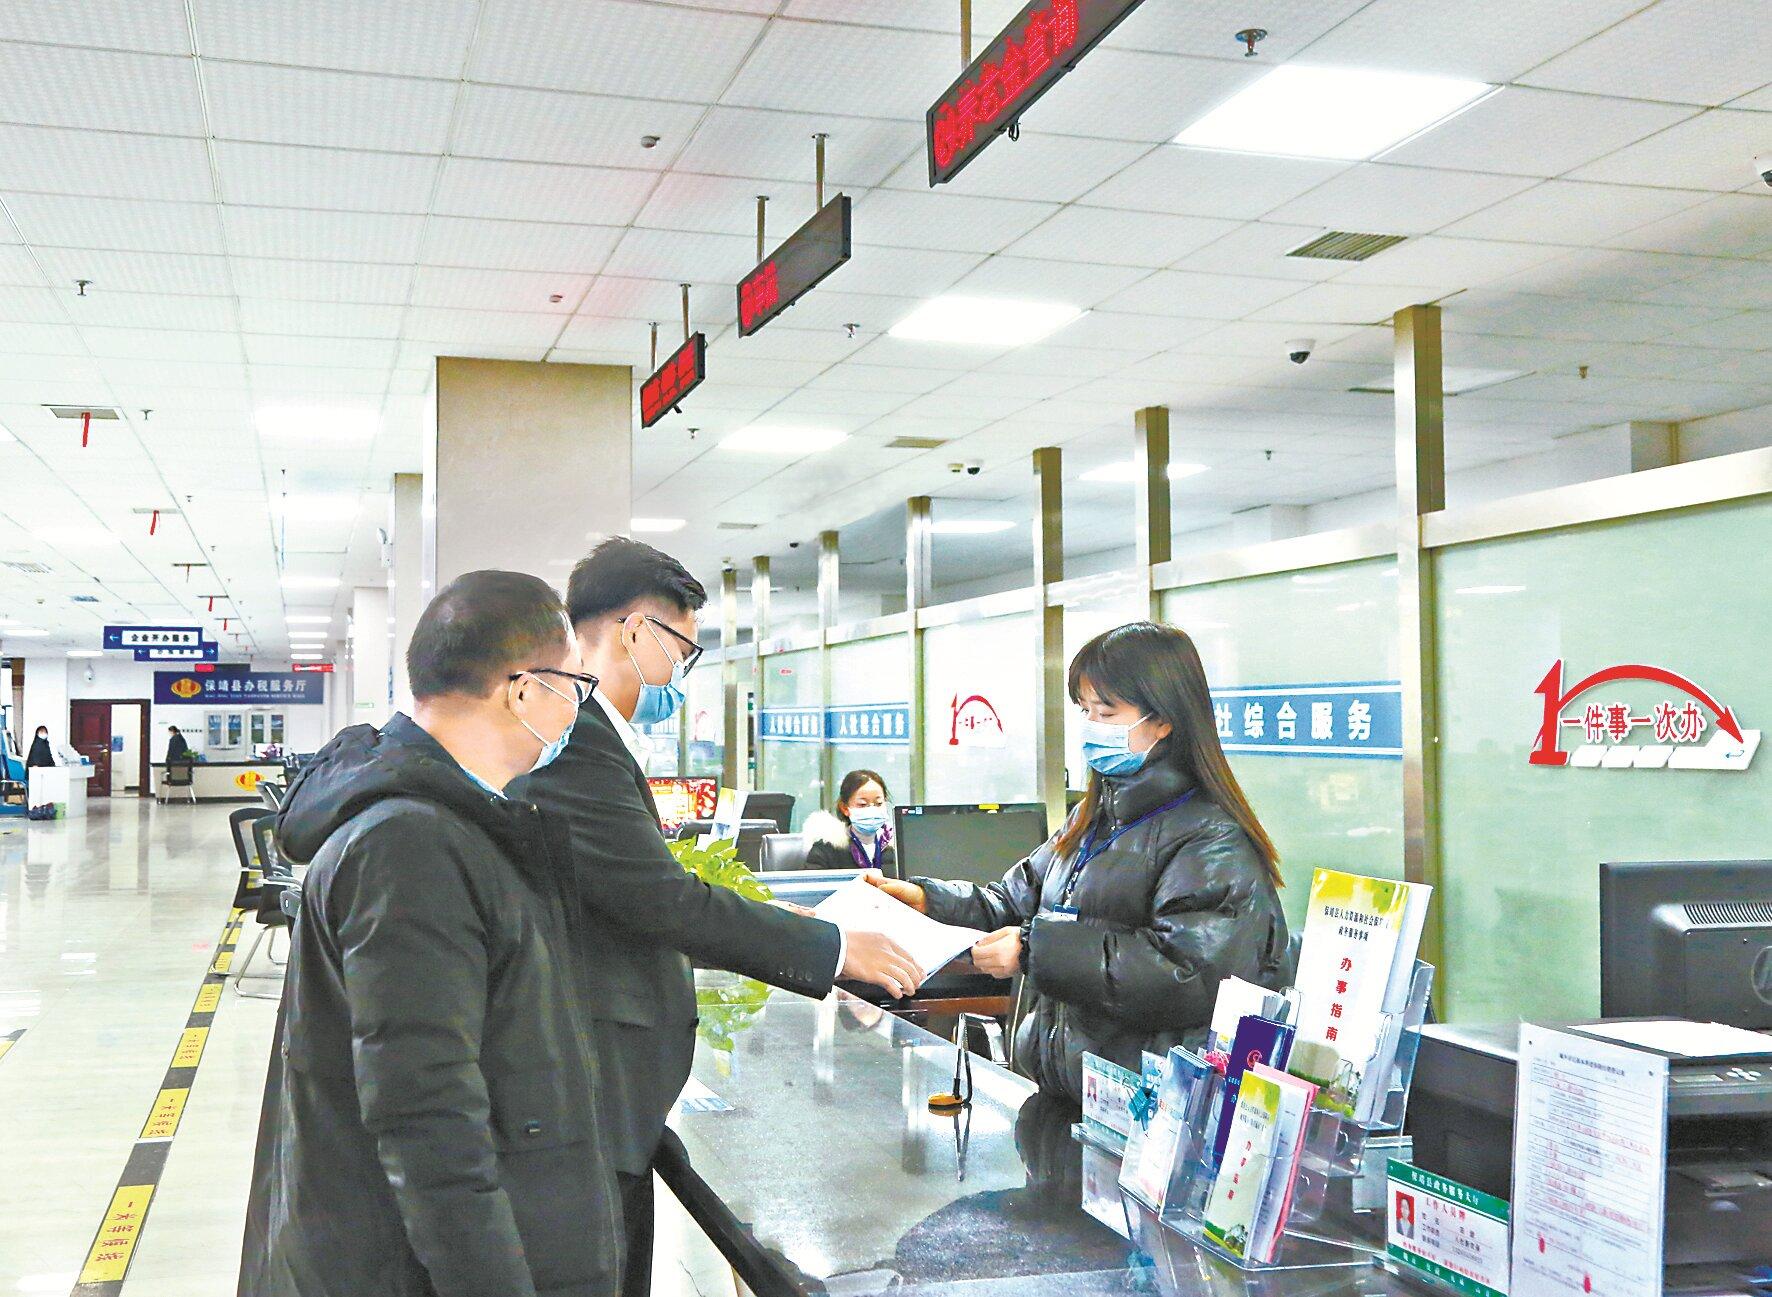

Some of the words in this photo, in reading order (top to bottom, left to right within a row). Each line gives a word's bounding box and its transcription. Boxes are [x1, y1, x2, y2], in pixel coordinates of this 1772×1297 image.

[131, 633, 190, 643] 企业开办服务
[204, 679, 307, 692] 保靖县办税服务厅
[839, 712, 904, 735] 人社综合服务
[1562, 704, 1703, 740] 一件事一次办
[1325, 957, 1352, 1042] 办事指南
